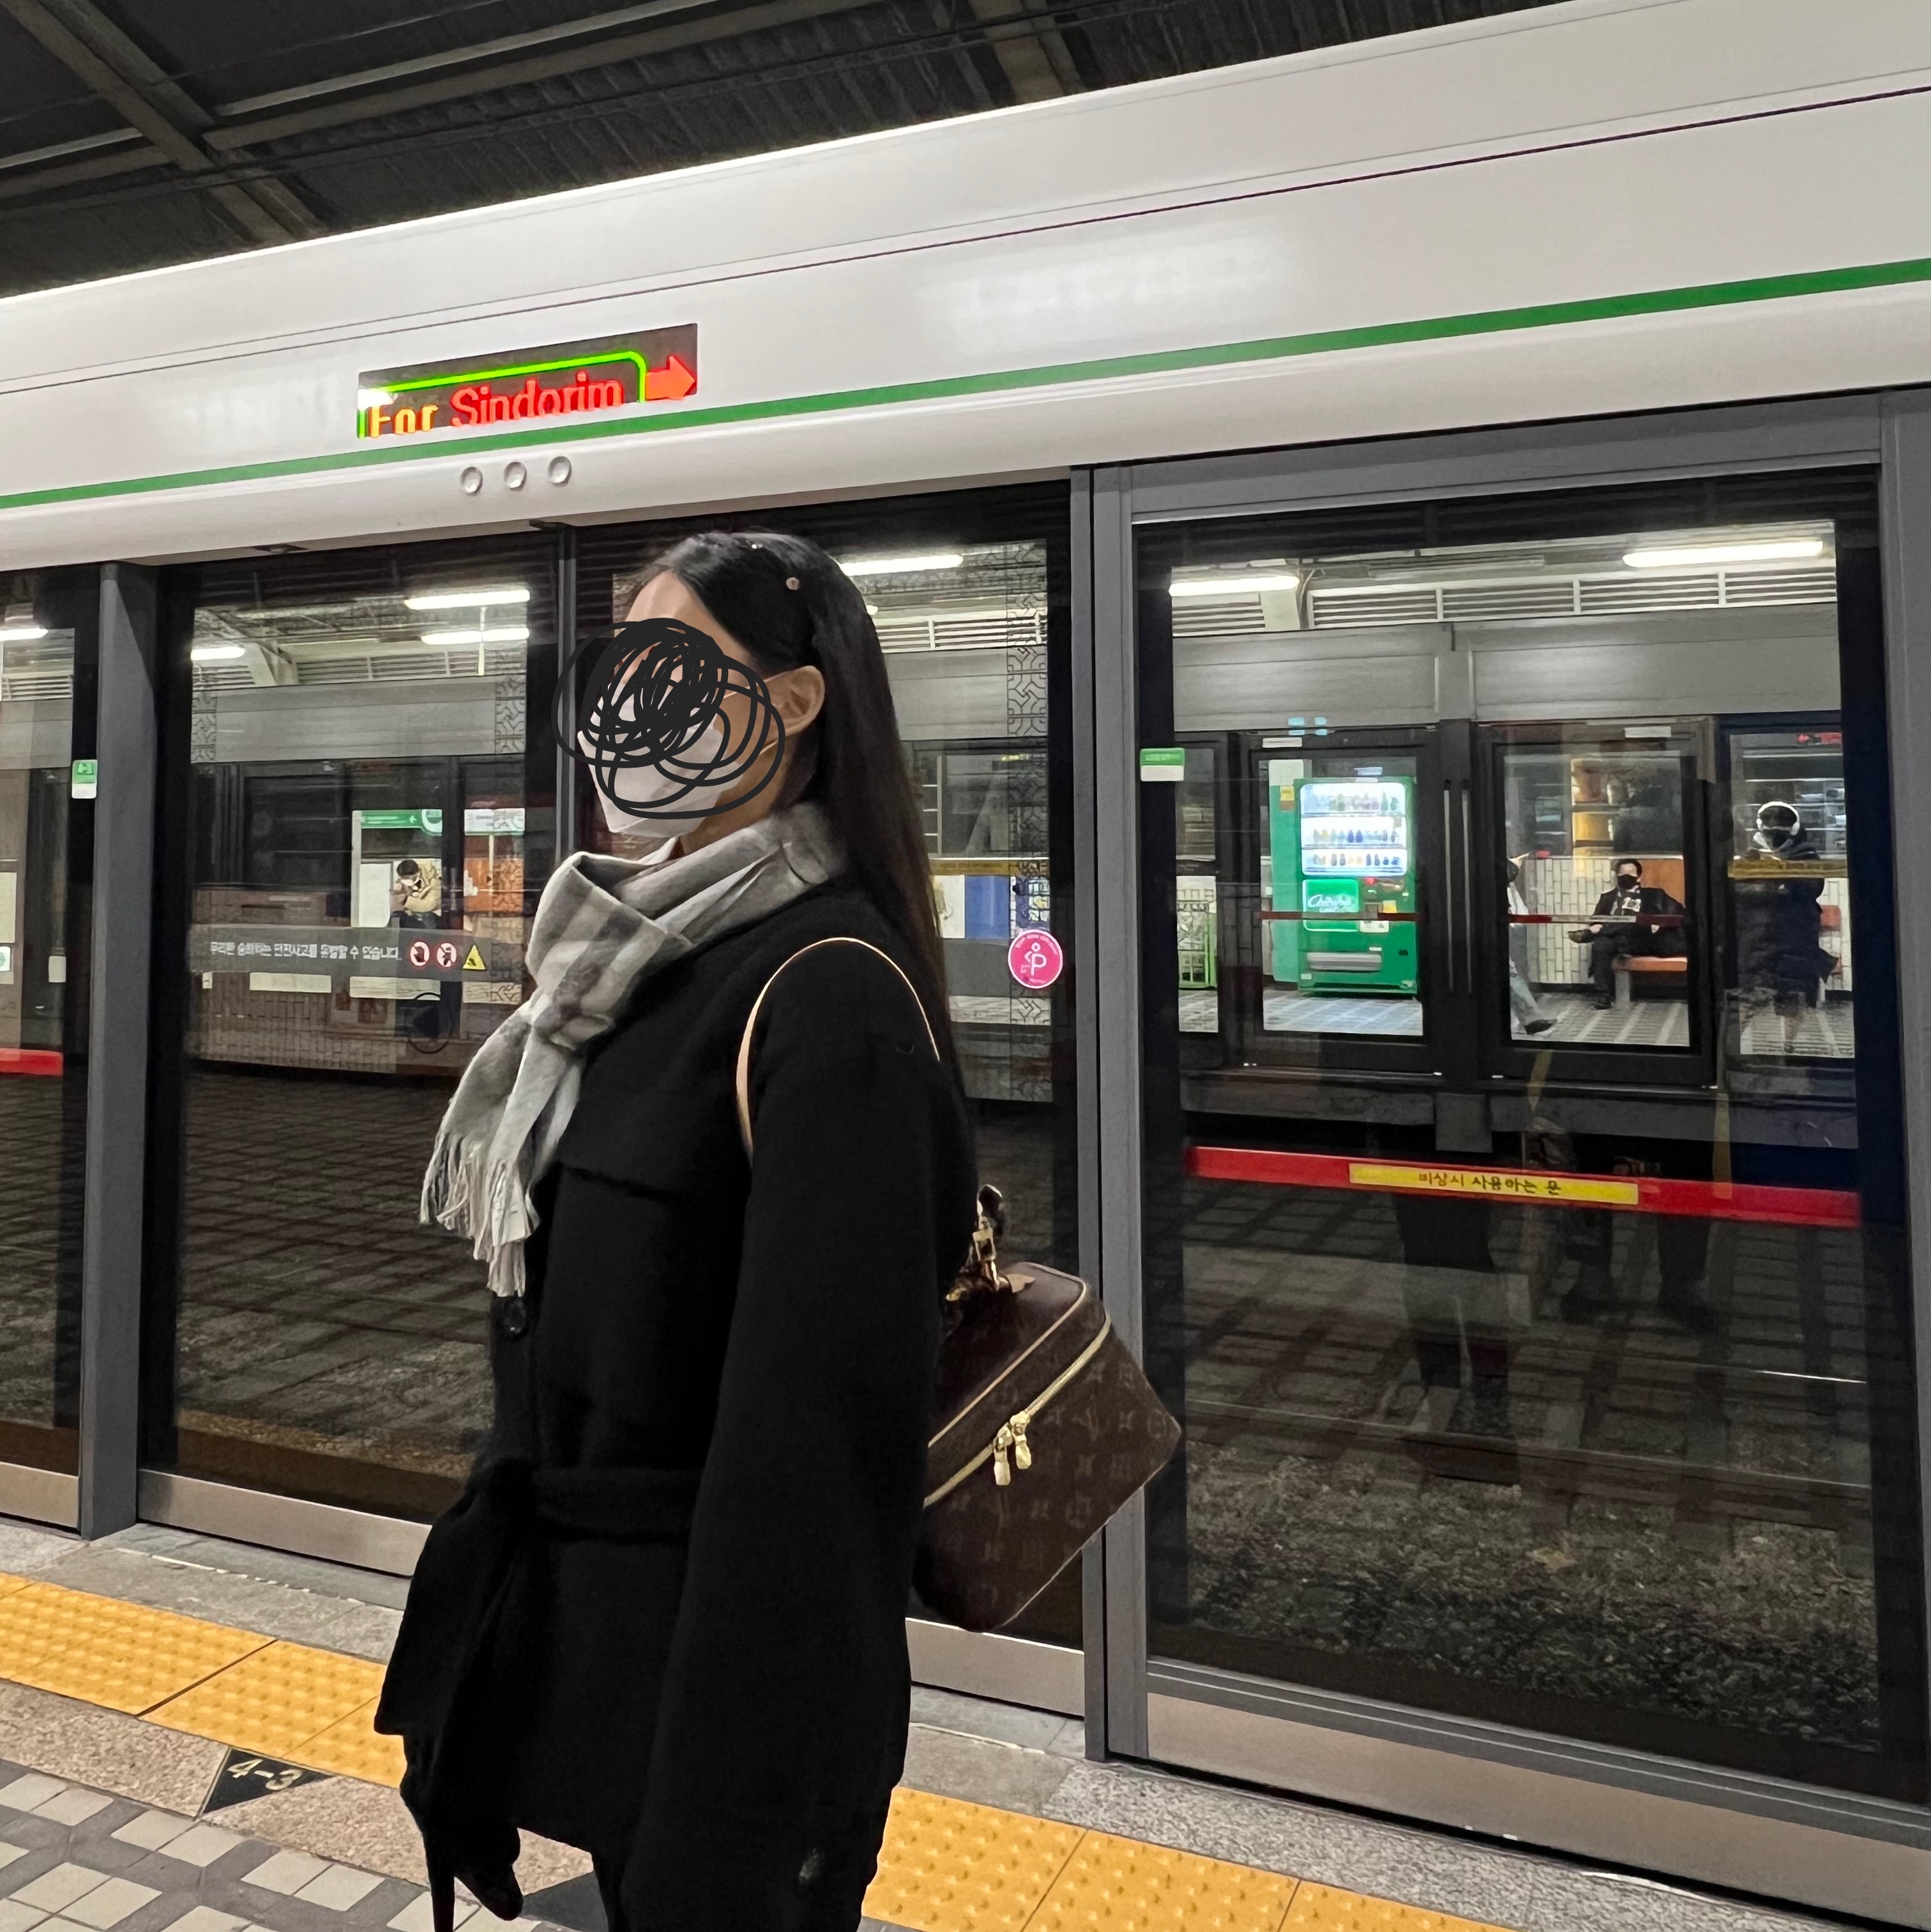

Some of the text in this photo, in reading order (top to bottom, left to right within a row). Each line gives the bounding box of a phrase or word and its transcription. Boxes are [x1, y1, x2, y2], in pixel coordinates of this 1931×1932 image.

[370, 370, 624, 437] For Sindorim
[1419, 1172, 1464, 1187] 비상시
[1472, 1175, 1538, 1194] 사용하는
[227, 1758, 303, 1791] 4-3
